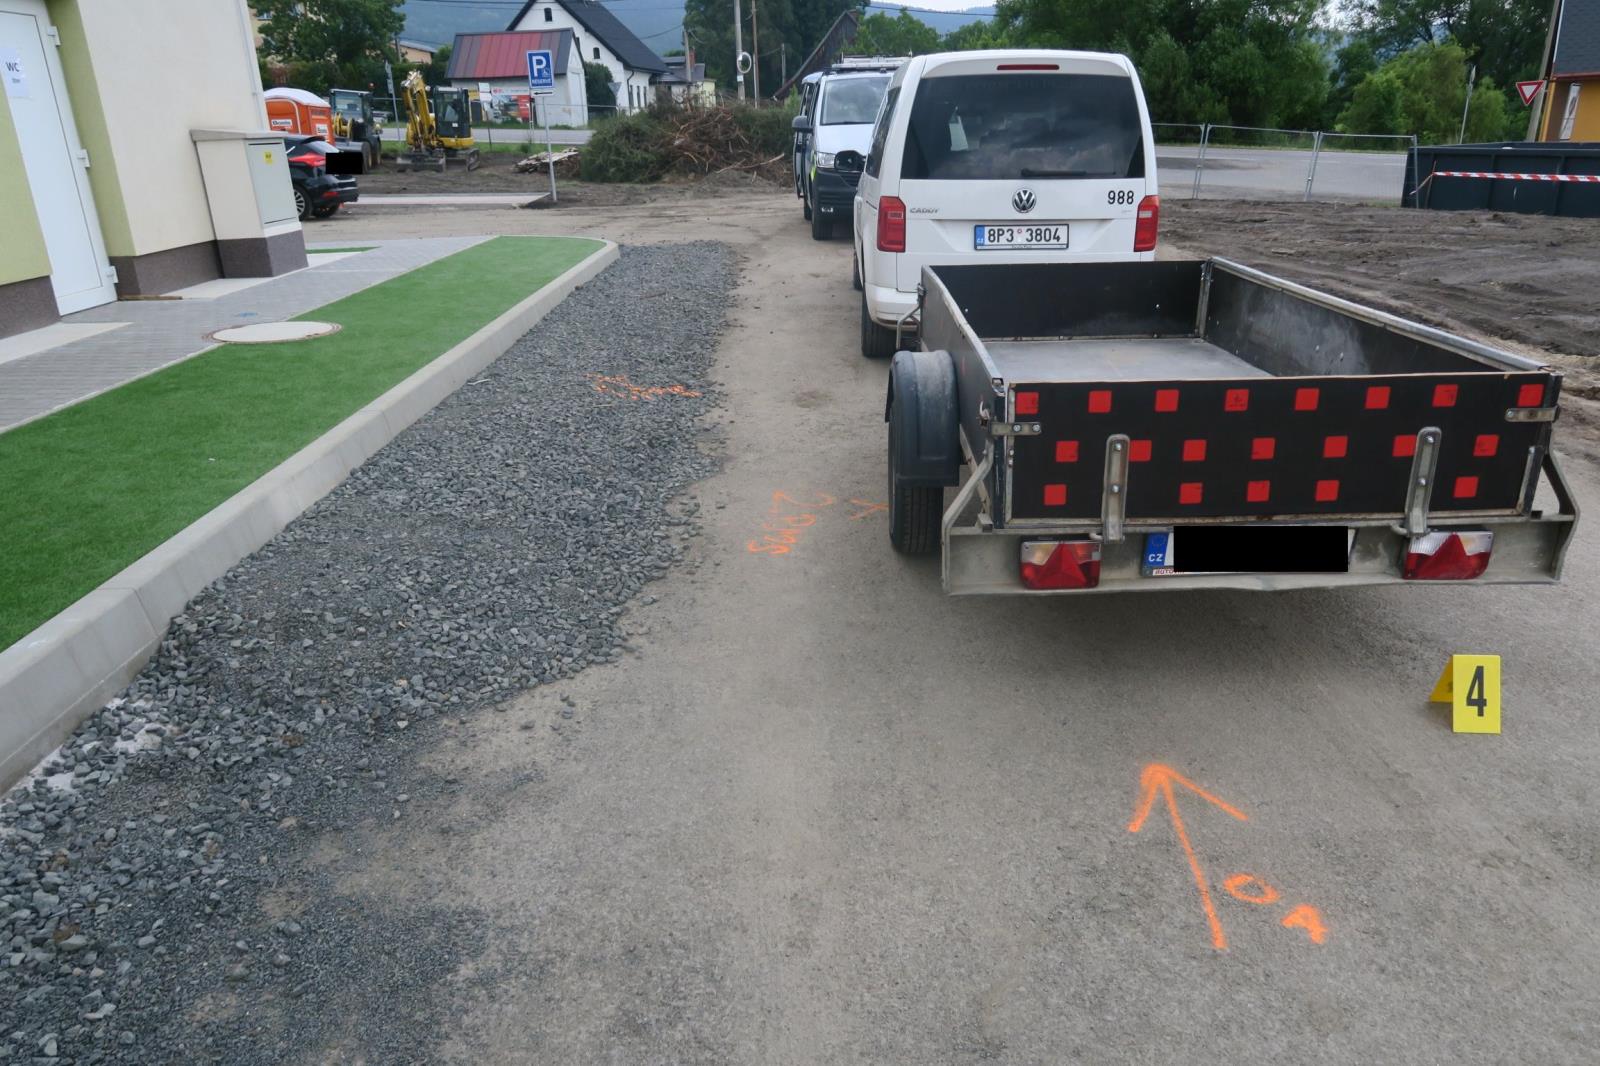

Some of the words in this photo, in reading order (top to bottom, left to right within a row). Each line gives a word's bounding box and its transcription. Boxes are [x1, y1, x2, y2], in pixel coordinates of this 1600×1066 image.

[5, 62, 20, 72] WC
[532, 55, 547, 77] P
[1108, 190, 1134, 205] 988
[988, 228, 1014, 243] 8P3
[1025, 228, 1060, 242] 3804
[1148, 553, 1164, 562] CZ
[1466, 665, 1488, 717] 4
